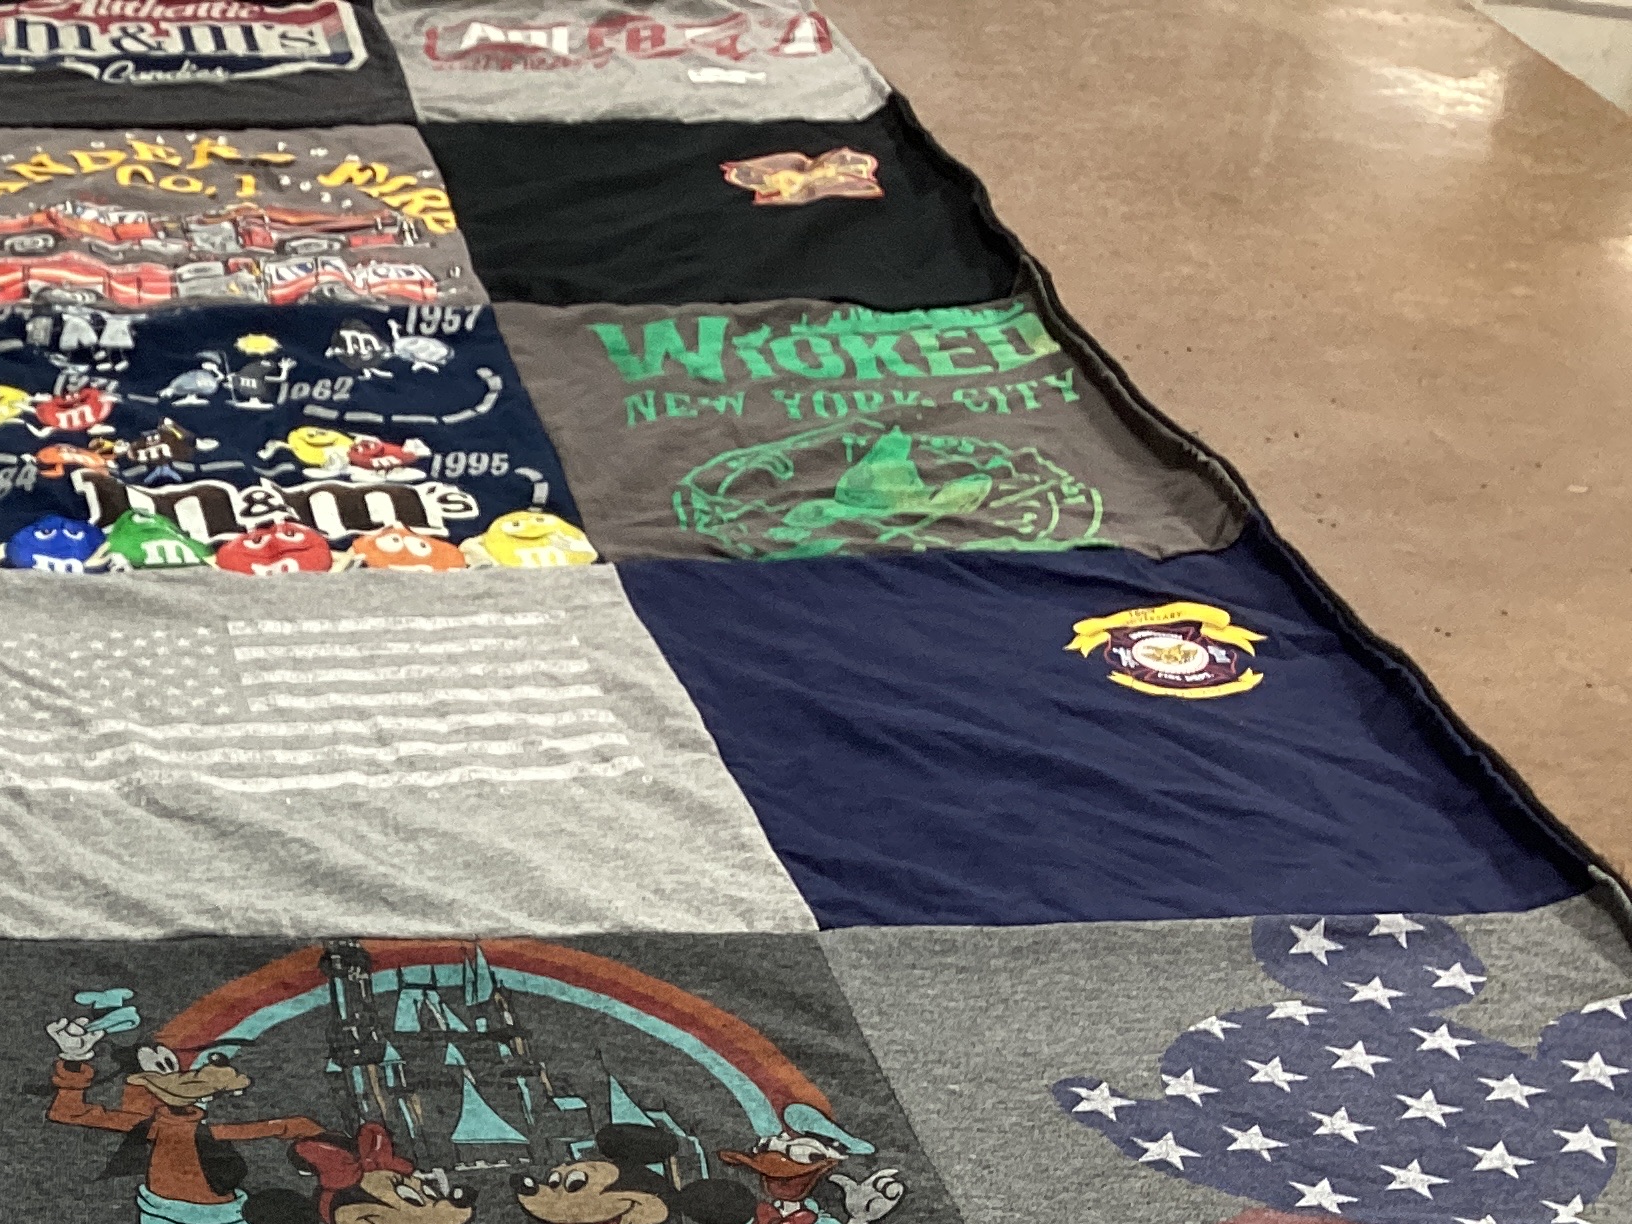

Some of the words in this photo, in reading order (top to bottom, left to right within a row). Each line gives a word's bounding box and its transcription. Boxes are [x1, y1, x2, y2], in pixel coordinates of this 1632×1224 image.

[406, 305, 482, 335] 1957
[952, 368, 1081, 416] CITY
[431, 453, 510, 479] 1995
[140, 539, 202, 565] m
